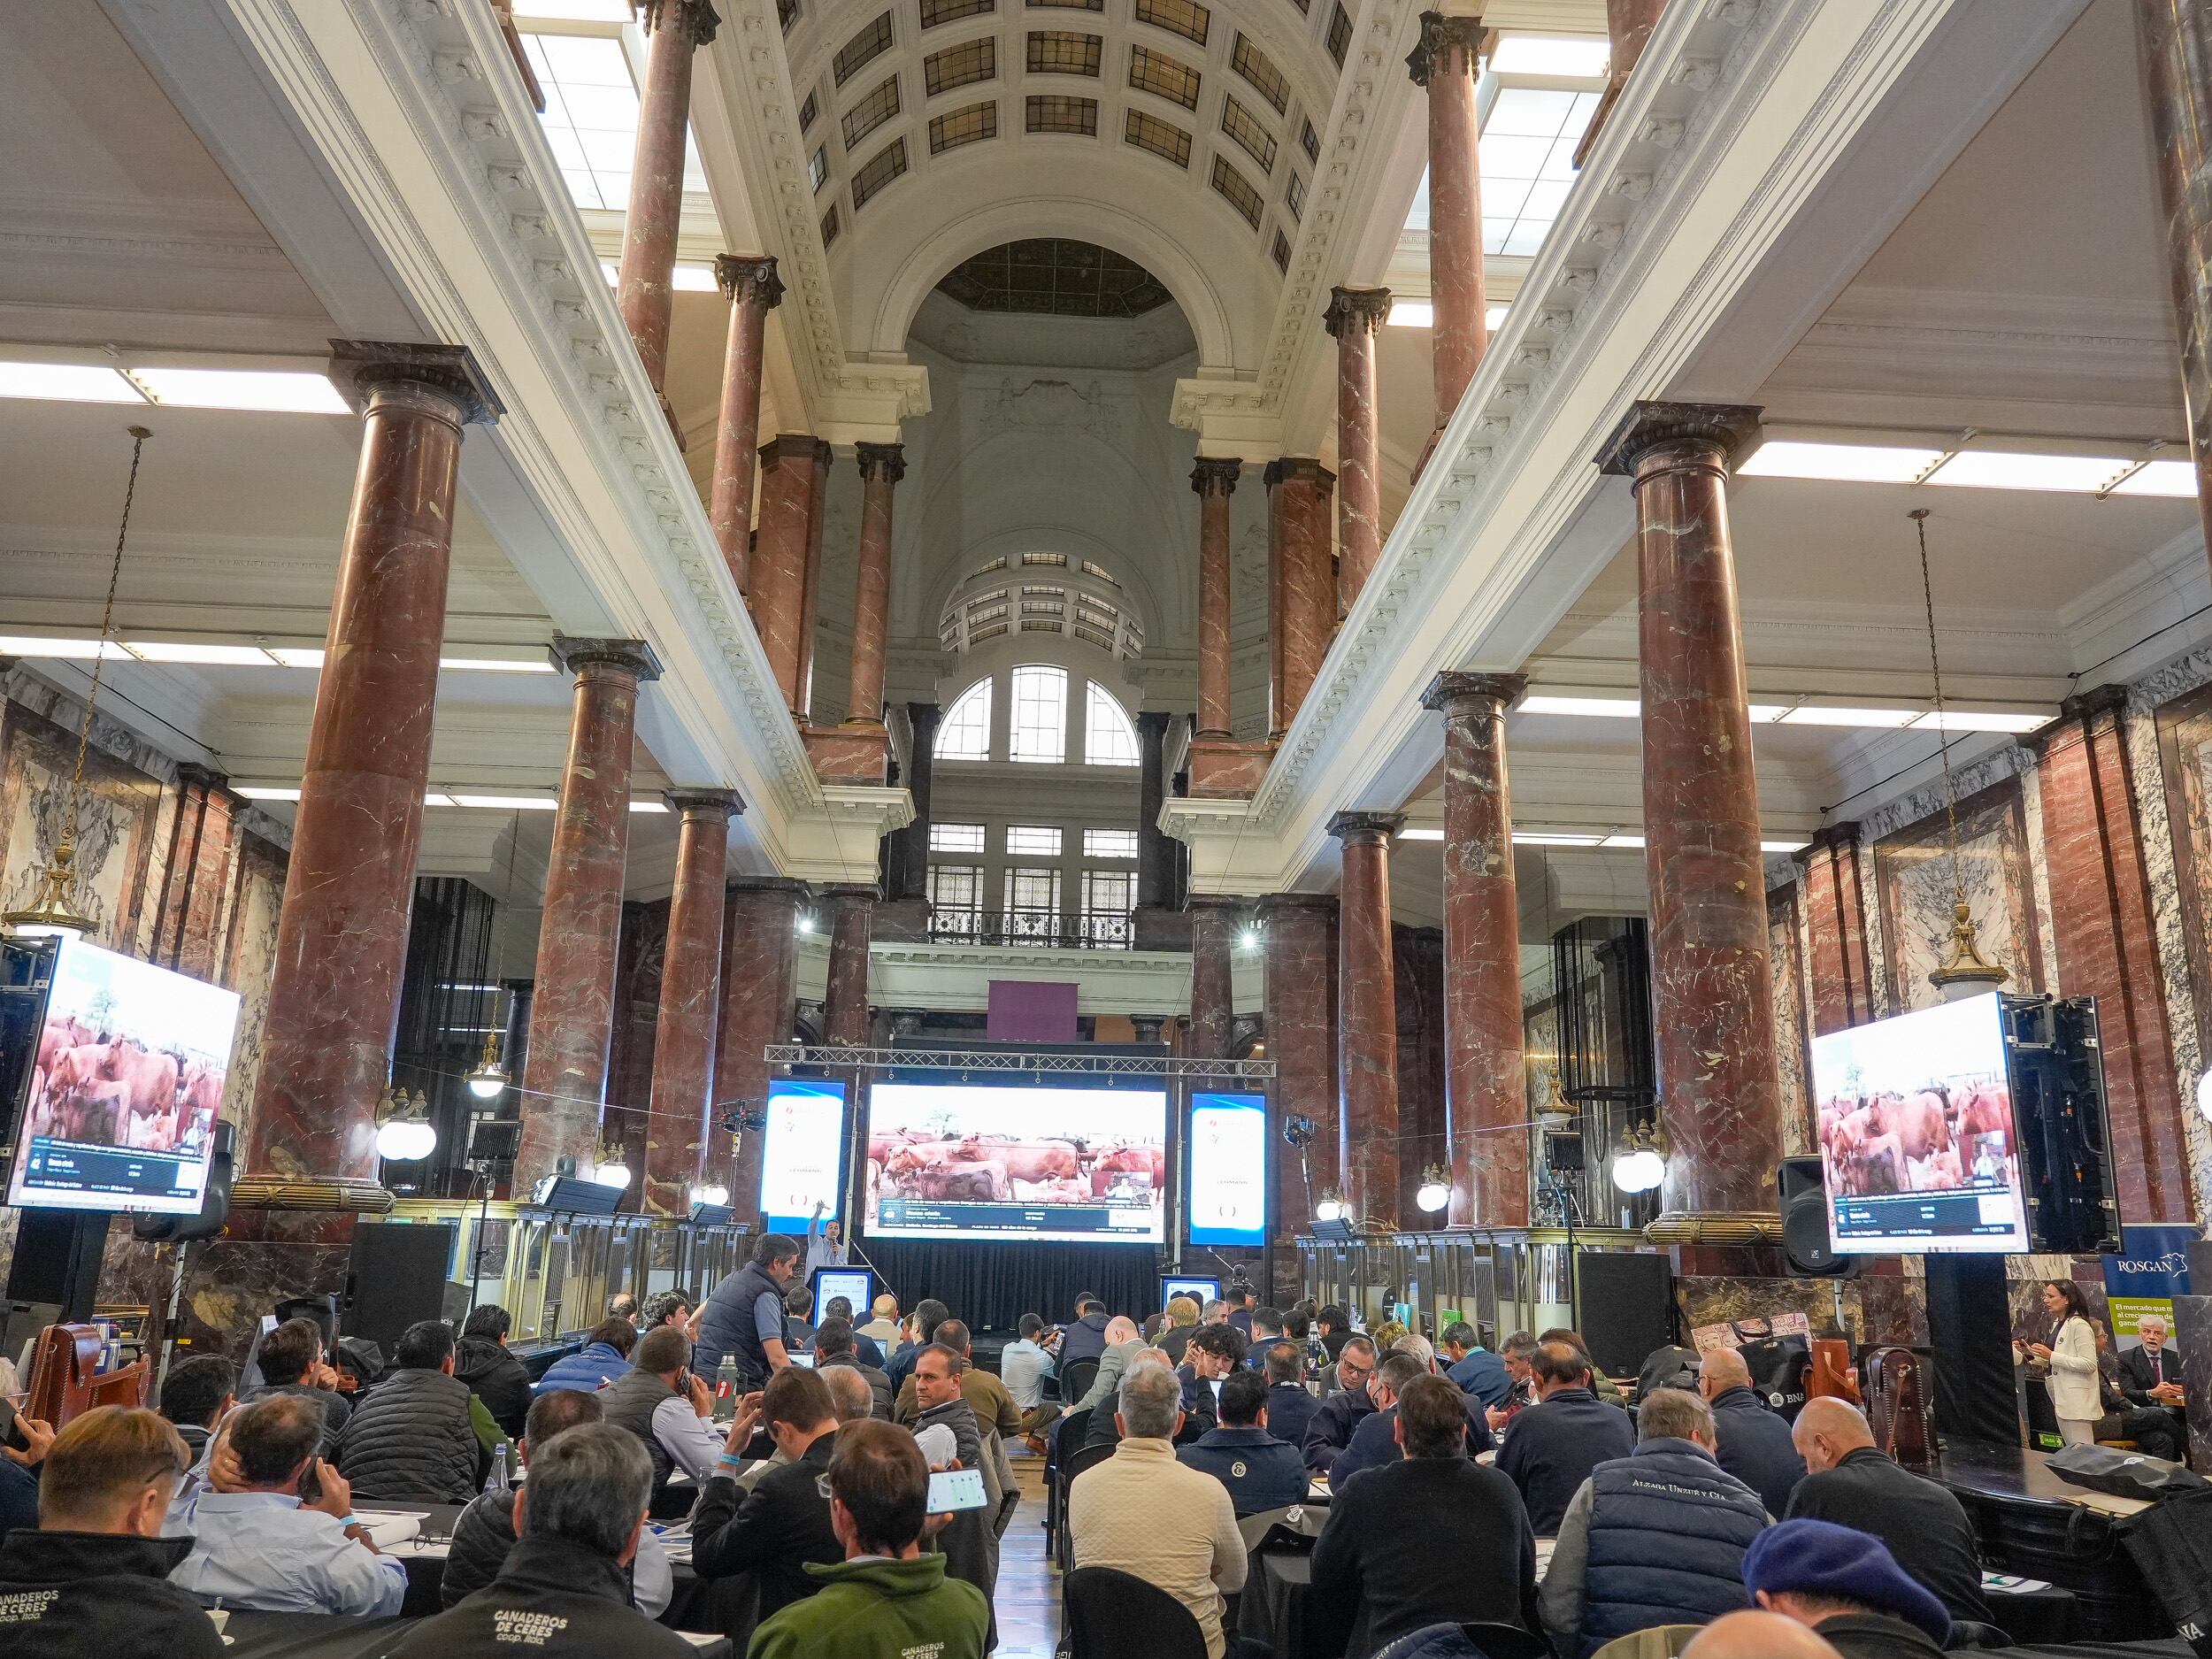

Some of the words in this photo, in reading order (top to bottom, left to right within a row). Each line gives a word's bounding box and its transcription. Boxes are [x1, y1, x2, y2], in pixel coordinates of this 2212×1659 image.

[2117, 1261, 2172, 1273] ROSGAN
[1786, 1393, 1805, 1403] BNA
[0, 1590, 59, 1605] ANADEROS
[0, 1604, 9, 1616] E
[10, 1601, 48, 1614] CERES
[494, 1610, 568, 1629] GANADEROS
[495, 1621, 513, 1632] DE
[514, 1623, 553, 1638] CERES
[902, 1641, 945, 1656] GANADEROS
